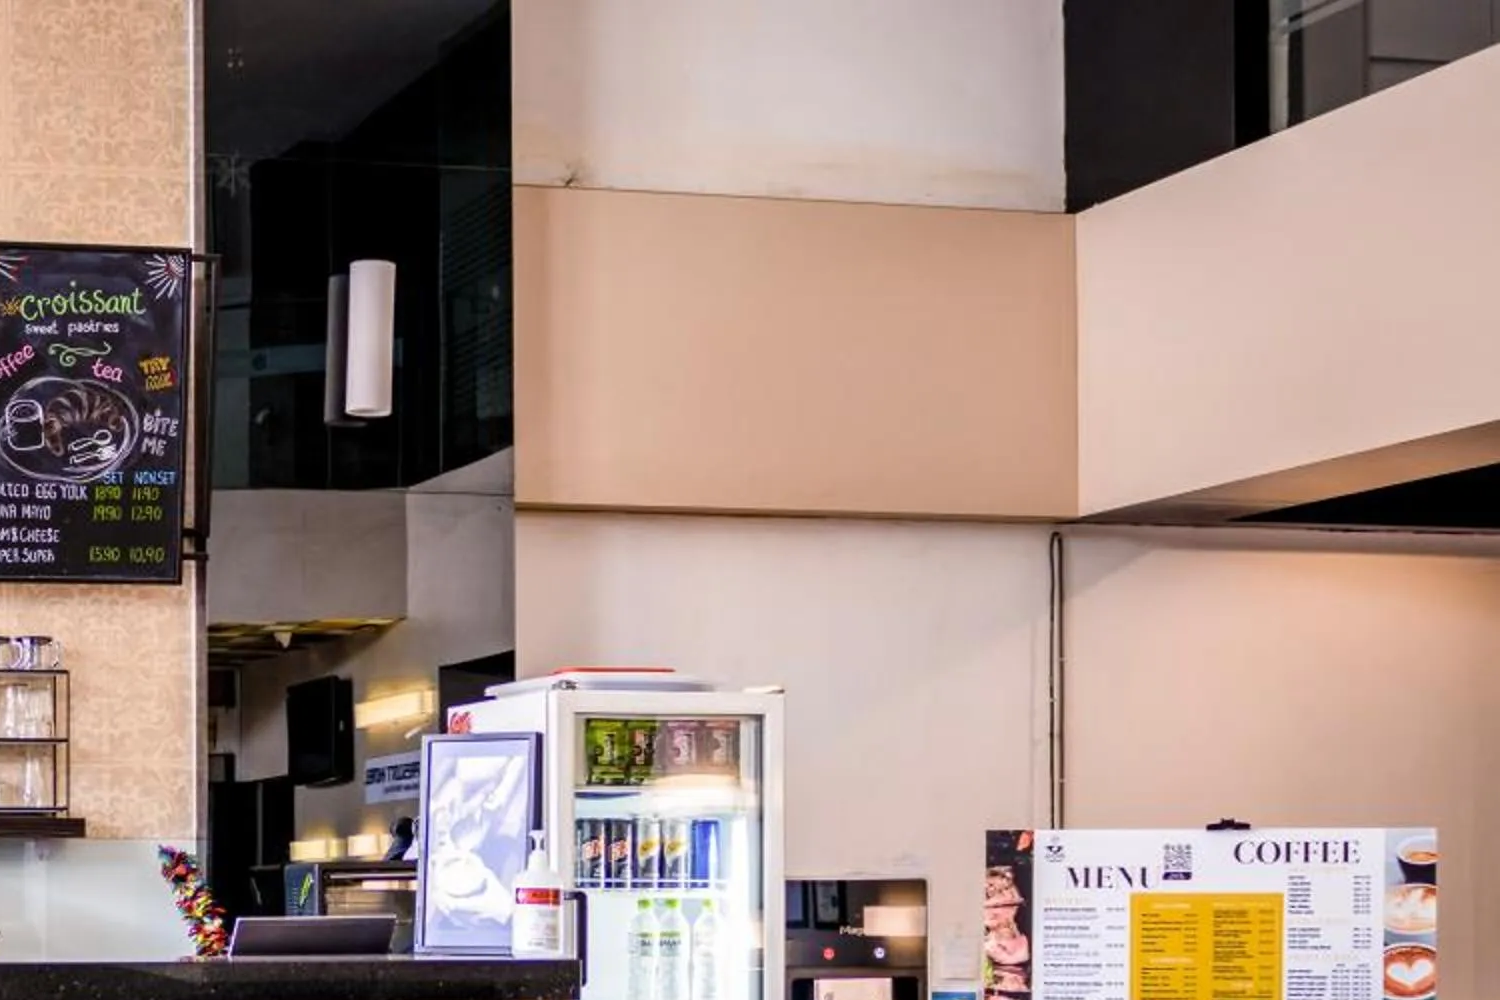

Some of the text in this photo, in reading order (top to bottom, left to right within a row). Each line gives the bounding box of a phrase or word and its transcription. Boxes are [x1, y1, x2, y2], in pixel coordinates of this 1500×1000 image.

[25, 320, 119, 337] sweet pastries
[91, 357, 123, 383] tea
[141, 437, 167, 457] ME
[103, 471, 124, 485] SET
[35, 483, 57, 499] EGG
[60, 484, 88, 500] YOLK
[21, 503, 51, 520] MAYO
[1234, 839, 1360, 865] COFFEE
[1066, 866, 1158, 889] MENU
